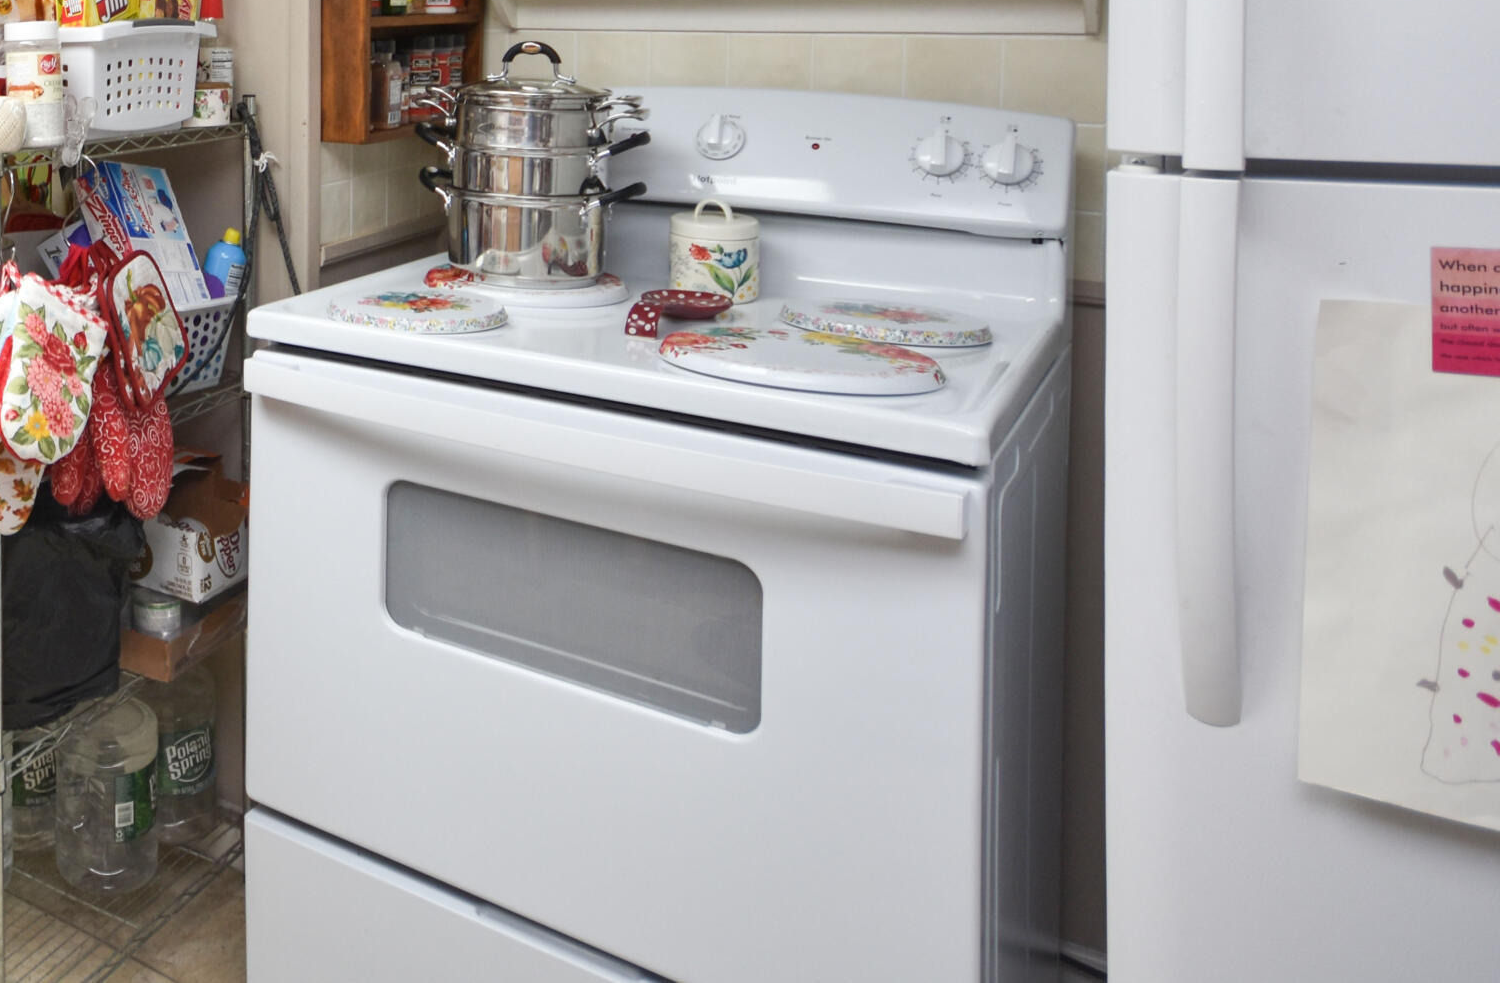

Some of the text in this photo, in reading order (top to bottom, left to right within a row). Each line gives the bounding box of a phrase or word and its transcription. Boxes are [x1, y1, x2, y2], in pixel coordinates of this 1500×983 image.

[1438, 259, 1487, 273] When
[1440, 280, 1500, 297] happin
[1440, 304, 1500, 316] another
[164, 728, 211, 764] Poland
[168, 745, 211, 781] Spring
